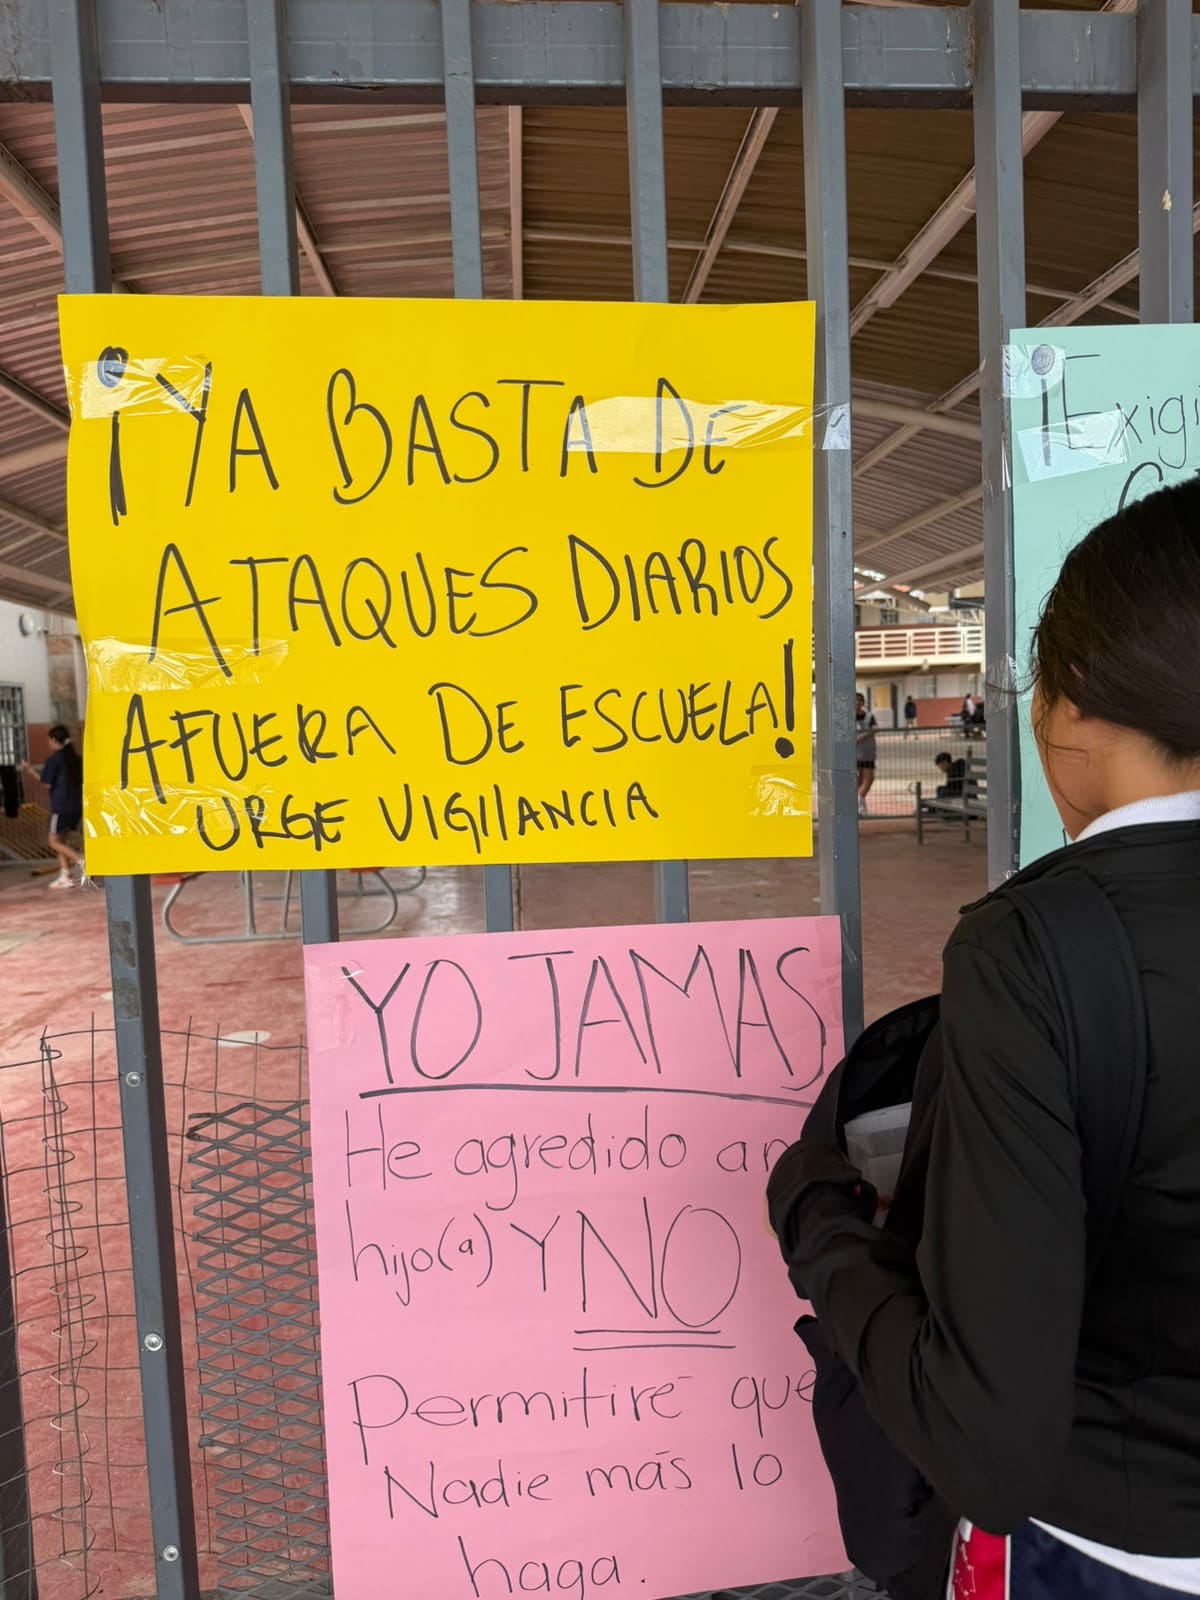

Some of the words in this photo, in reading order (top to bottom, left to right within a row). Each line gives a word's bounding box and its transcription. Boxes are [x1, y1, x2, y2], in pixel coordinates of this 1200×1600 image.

[325, 367, 598, 504] BASTA
[632, 376, 747, 488] DE
[148, 543, 537, 678] ATAQUES
[568, 534, 793, 631] DIARIOS
[121, 693, 396, 804] AFUERA
[428, 681, 525, 765] DE
[560, 638, 796, 760] ESCUELA!
[196, 794, 346, 852] URGE
[341, 958, 483, 1084] YO
[507, 944, 827, 1091] JAMAS
[346, 1102, 433, 1190] He
[454, 1104, 688, 1212] agredido
[345, 1199, 494, 1306] hijo(a)
[731, 1368, 818, 1439] que
[384, 1458, 553, 1519] Nadie
[585, 1450, 692, 1496] más
[731, 1443, 783, 1491] lo
